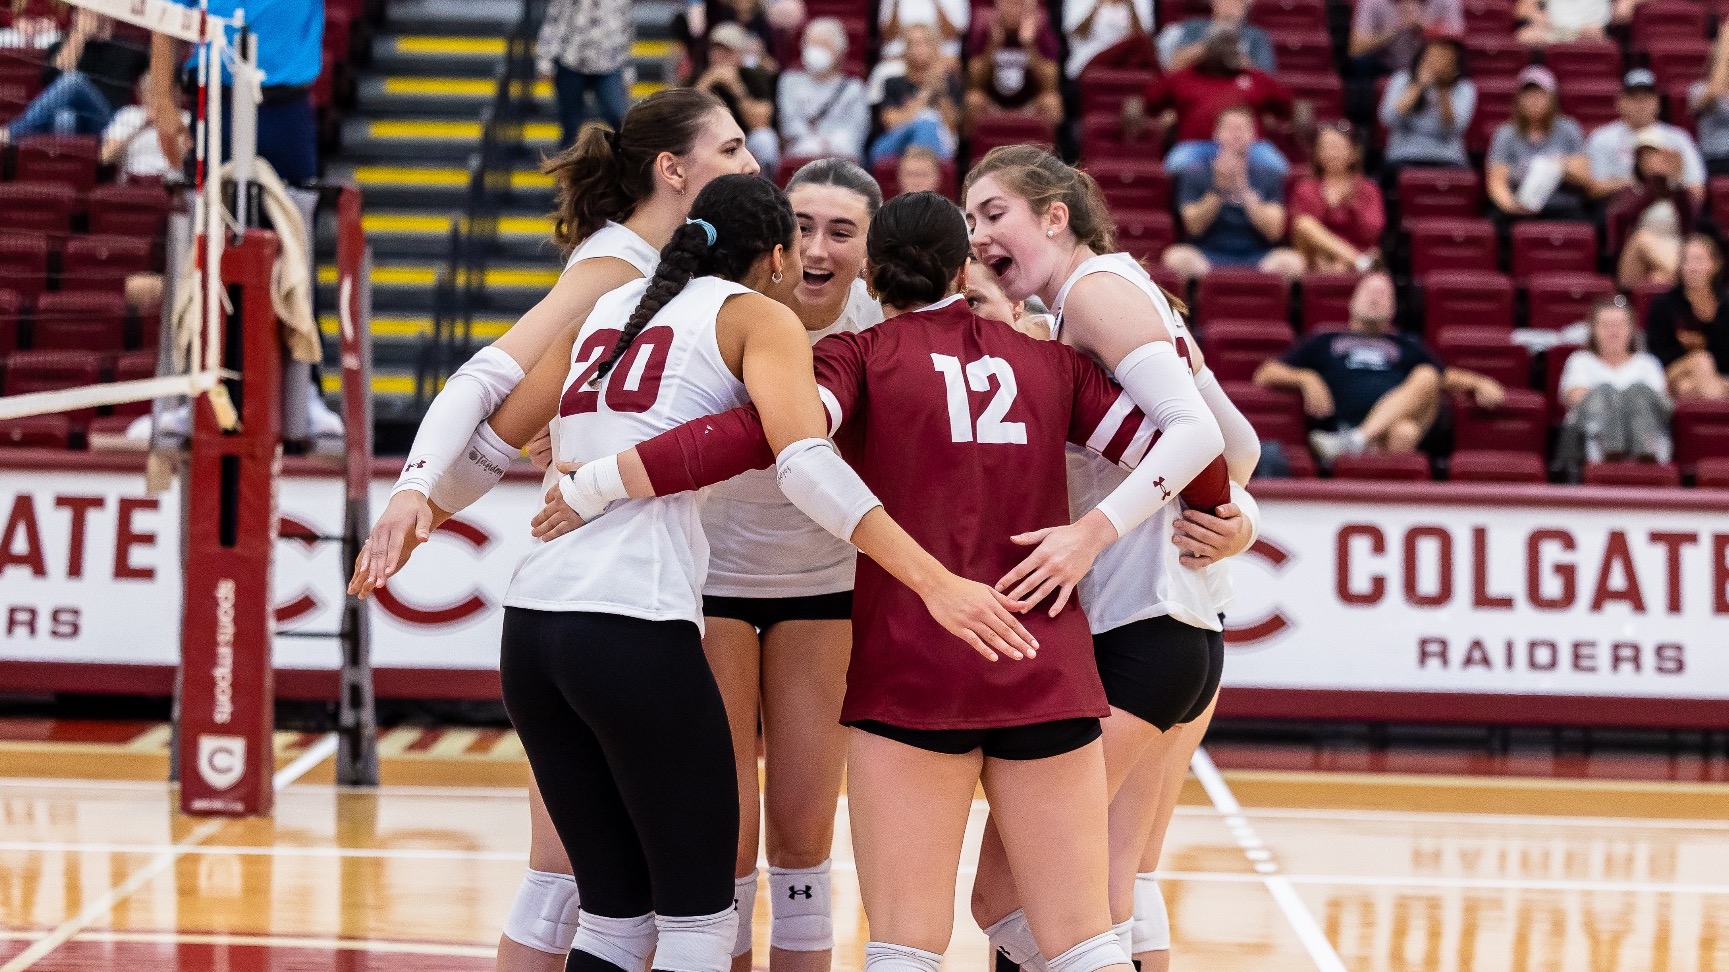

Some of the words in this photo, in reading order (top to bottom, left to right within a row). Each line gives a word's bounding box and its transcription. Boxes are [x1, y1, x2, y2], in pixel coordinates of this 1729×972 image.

[560, 326, 674, 418] 20
[930, 353, 1027, 444] 12
[1417, 638, 1686, 674] RAIDERS
[207, 746, 234, 774] C
